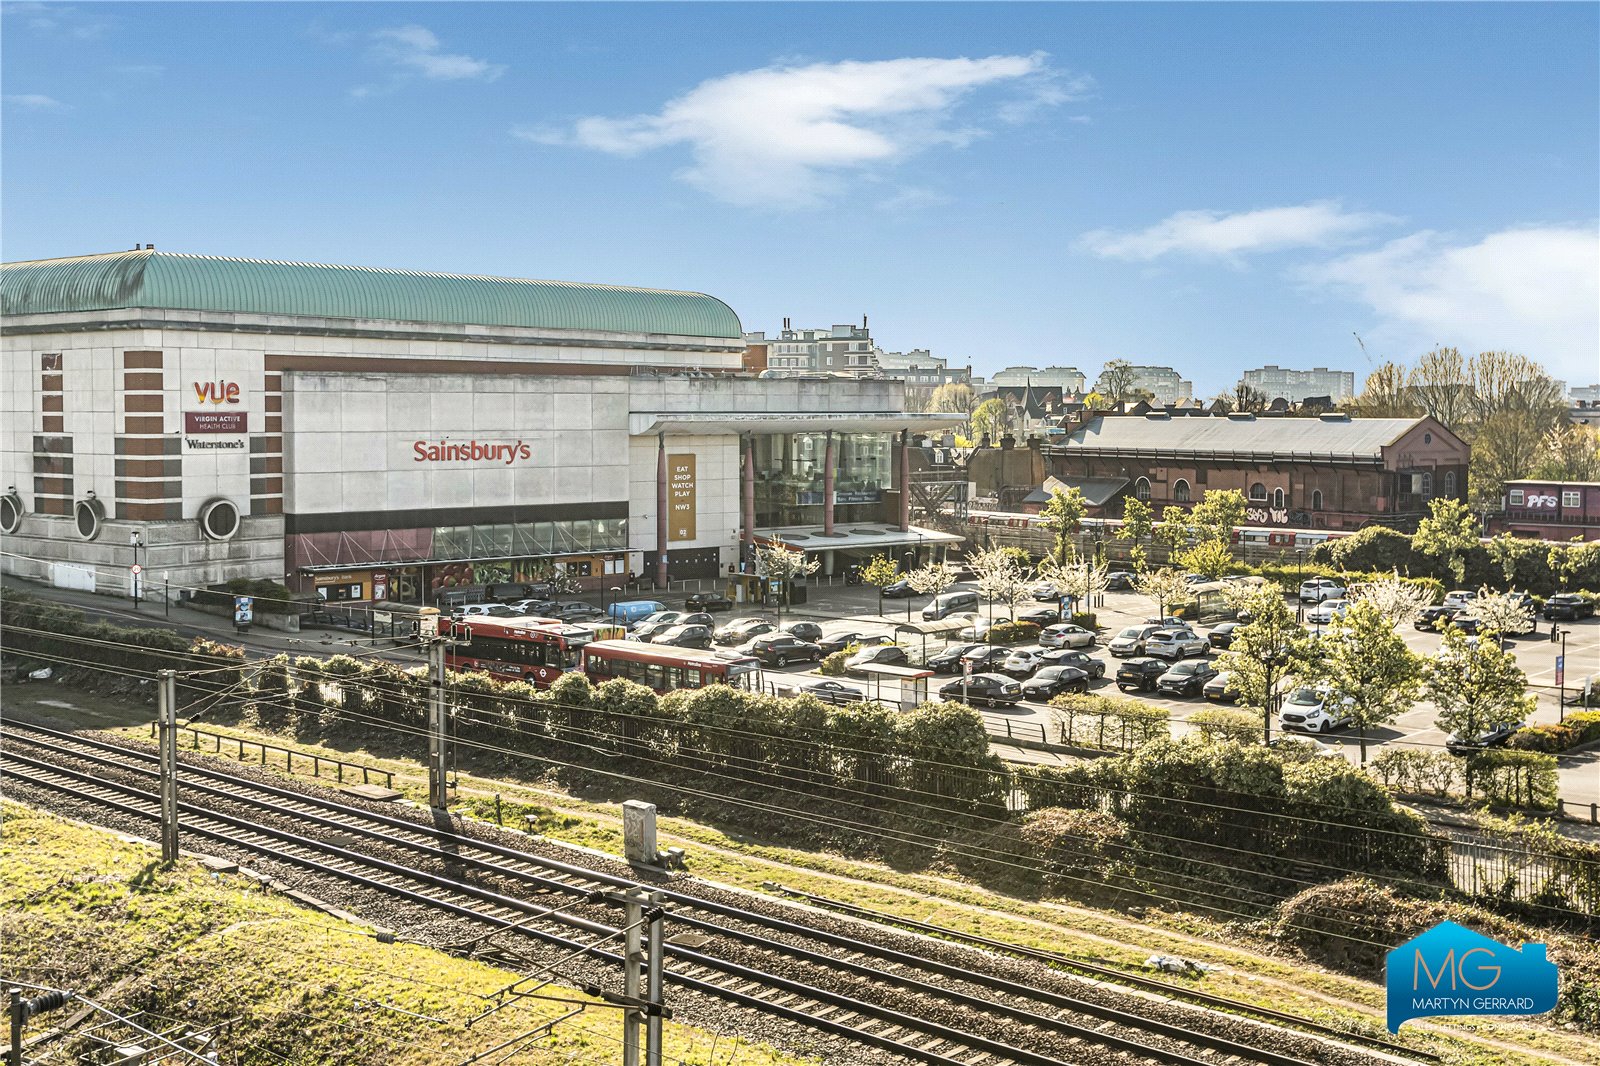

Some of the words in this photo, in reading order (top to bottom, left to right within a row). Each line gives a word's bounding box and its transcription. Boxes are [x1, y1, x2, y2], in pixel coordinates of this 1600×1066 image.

[186, 439, 245, 449] Waterstone's
[413, 440, 531, 465] Sainsbury's
[1527, 494, 1558, 508] PFS
